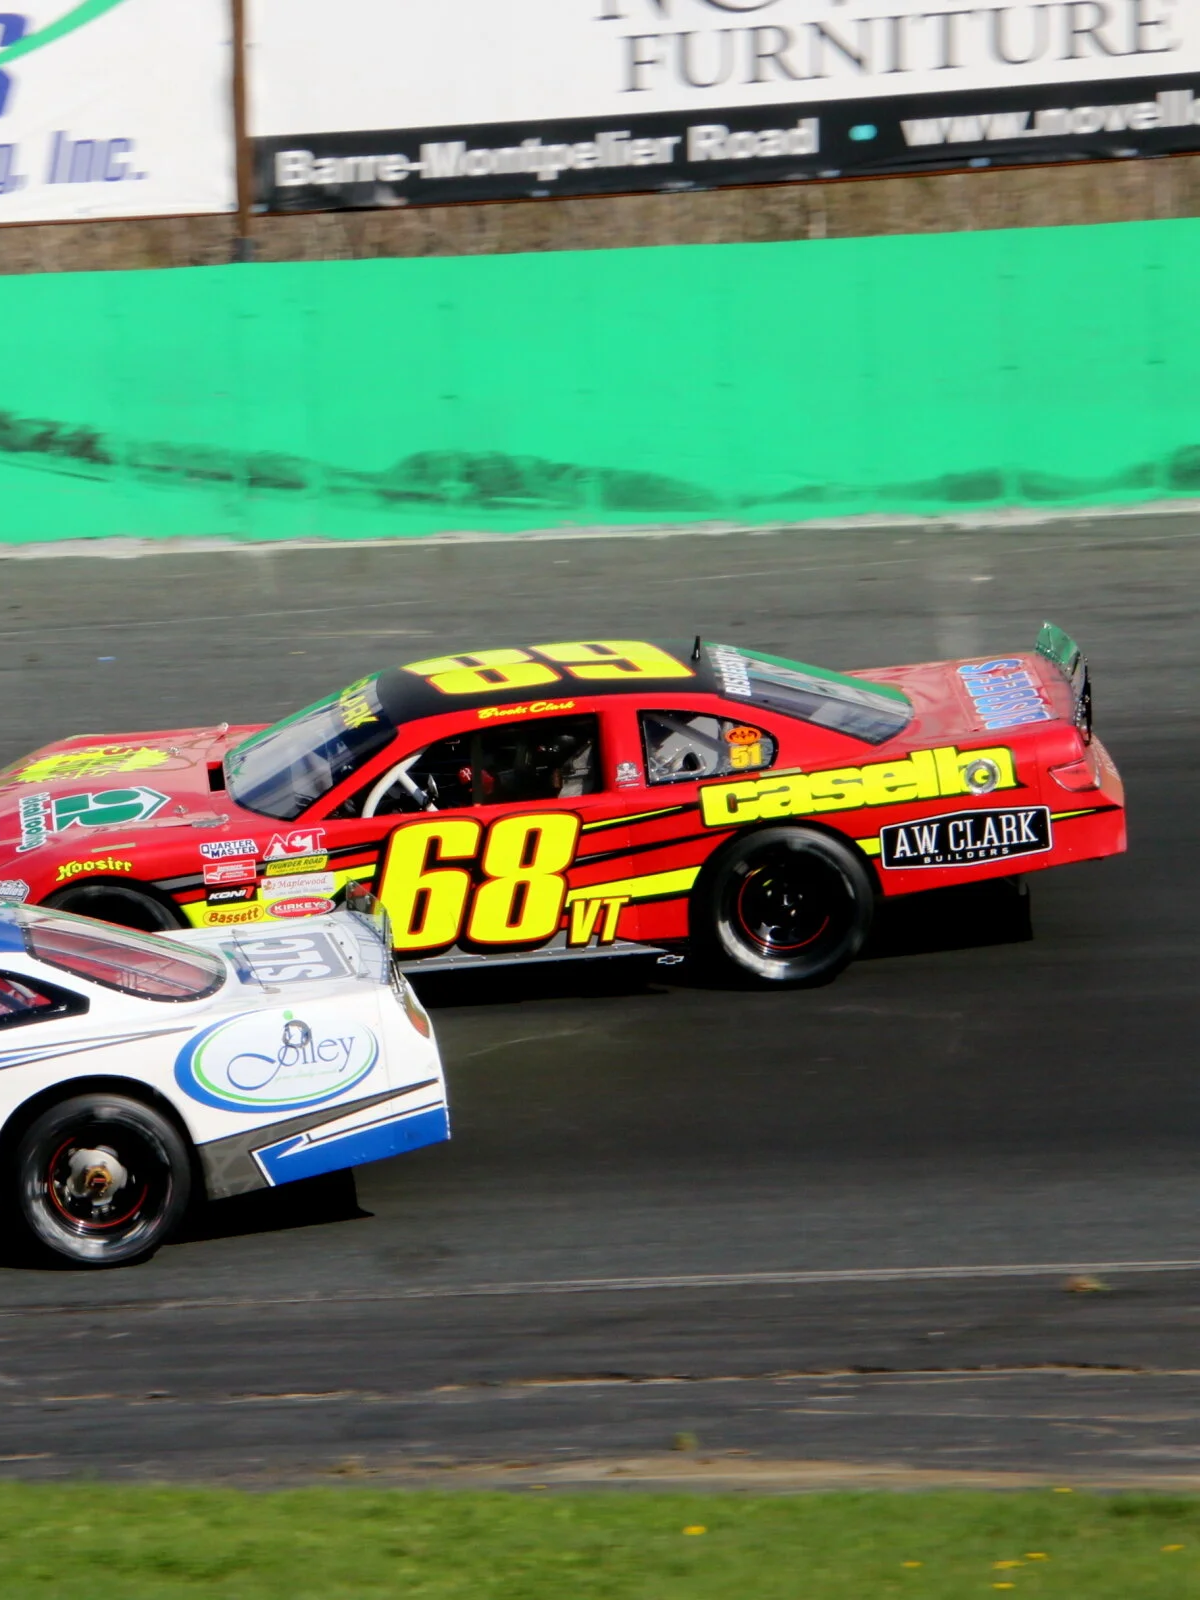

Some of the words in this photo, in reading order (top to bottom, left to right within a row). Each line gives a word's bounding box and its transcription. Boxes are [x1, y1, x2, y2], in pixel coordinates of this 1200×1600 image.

[616, 0, 1182, 93] FURNITURE
[275, 130, 681, 187] Barre-Montpelier
[688, 117, 819, 163] Road
[900, 89, 1200, 147] www.novell
[45, 131, 148, 185] Inc.
[529, 701, 575, 713] Clark
[957, 658, 1050, 730] BISBEE'S
[730, 743, 762, 769] 51
[949, 811, 1039, 851] CLARK
[201, 839, 253, 854] QUARTER
[211, 846, 256, 858] MASTER
[923, 847, 1010, 864] BUILDERS
[55, 856, 132, 882] Hoosier
[269, 860, 303, 870] THUNDER
[303, 857, 324, 866] ROAD
[208, 888, 247, 900] KONI
[377, 809, 583, 955] 68
[208, 907, 260, 924] Bassett
[274, 902, 321, 912] KIRKEY
[567, 895, 630, 947] VT
